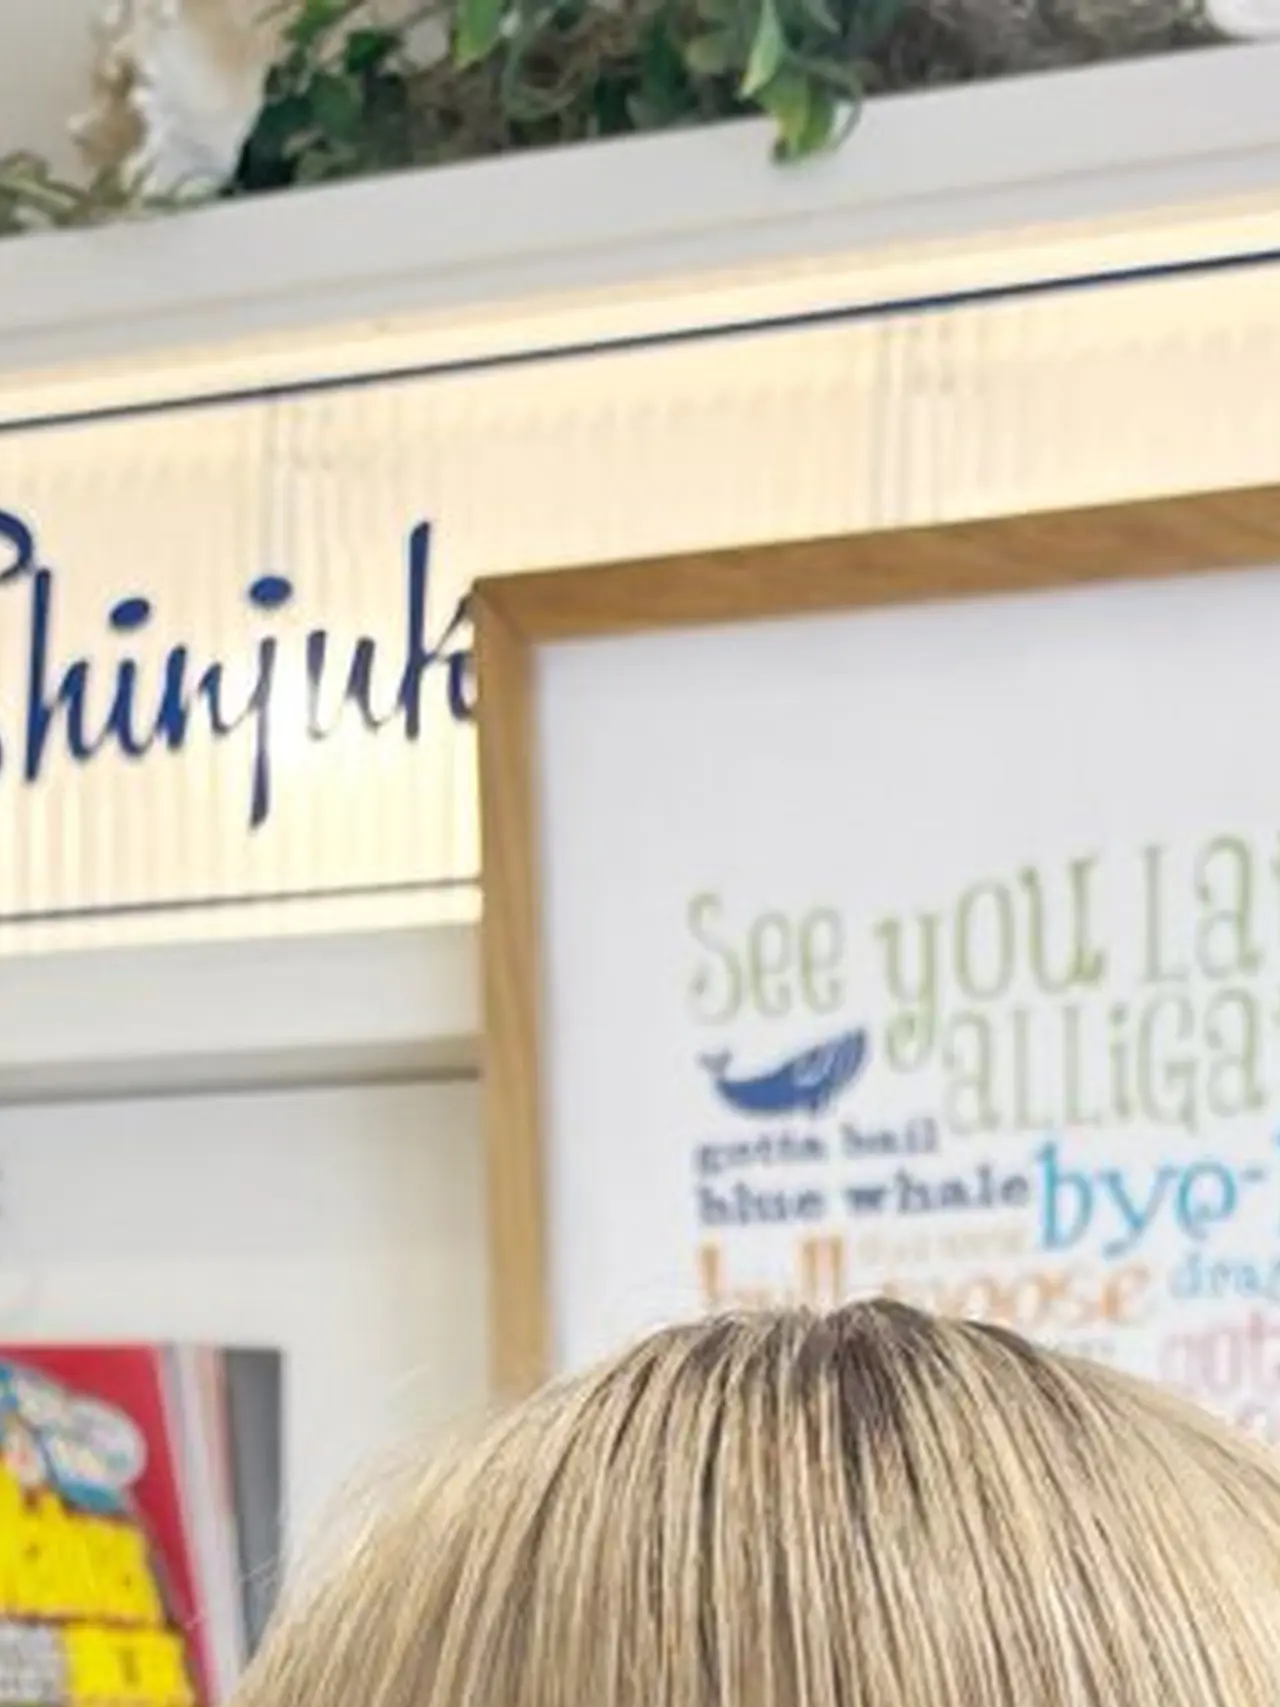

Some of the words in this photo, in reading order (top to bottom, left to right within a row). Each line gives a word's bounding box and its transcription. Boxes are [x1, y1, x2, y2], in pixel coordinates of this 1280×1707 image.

[686, 889, 847, 1026] See
[873, 857, 1106, 1073] you
[697, 1180, 826, 1228] blue
[844, 1160, 1030, 1218] whale
